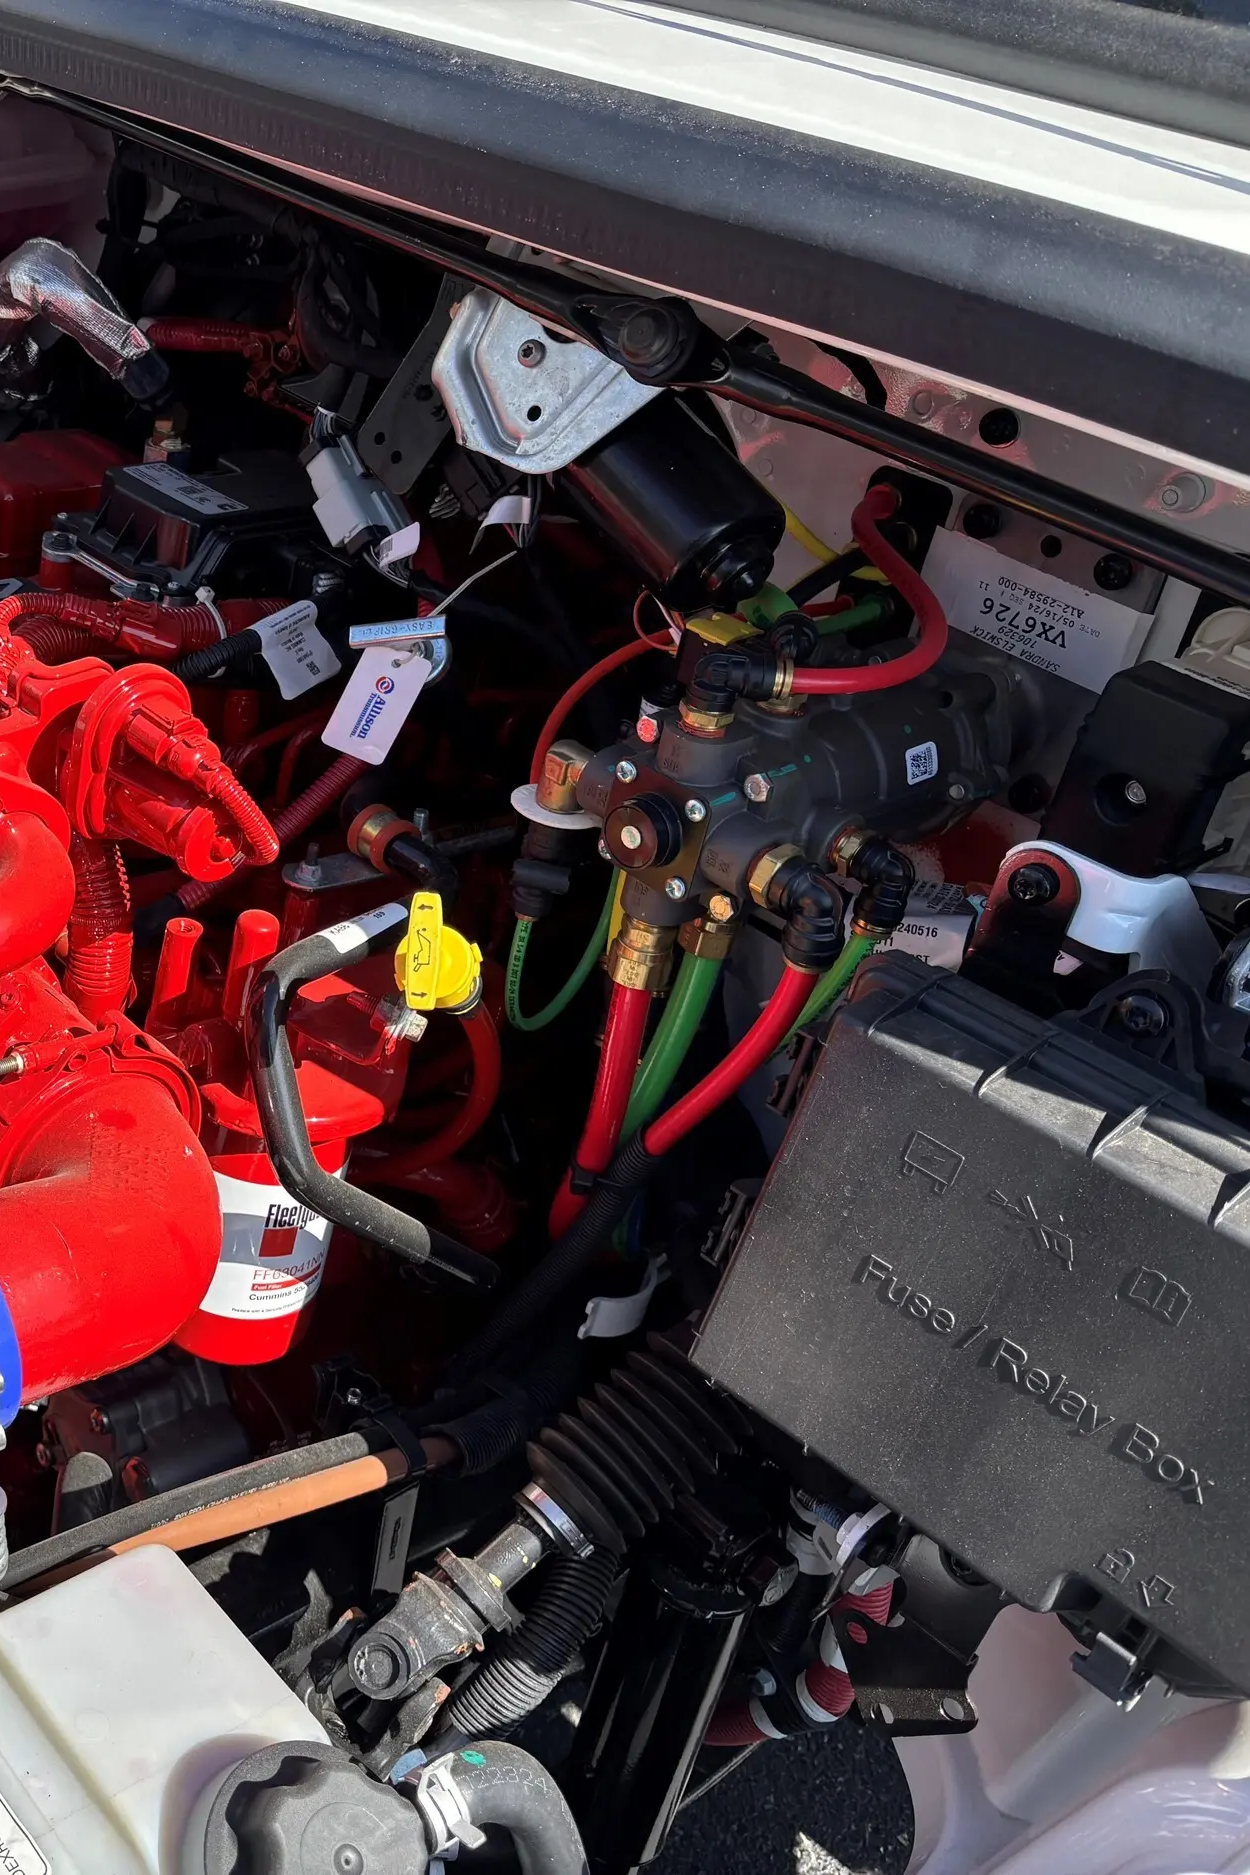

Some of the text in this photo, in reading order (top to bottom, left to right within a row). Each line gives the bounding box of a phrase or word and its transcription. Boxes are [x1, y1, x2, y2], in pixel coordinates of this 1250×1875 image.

[996, 575, 1084, 619] A12-29584-000
[1026, 601, 1075, 628] 05/16/24
[978, 595, 1071, 649] VX6726
[997, 624, 1037, 648] 106329
[969, 624, 1060, 673] SANDRA ELSWICK
[356, 694, 387, 740] Allison
[892, 922, 937, 937] 240516
[248, 1290, 291, 1301] Cummins
[856, 1253, 1215, 1507] Fuse / Relay Box
